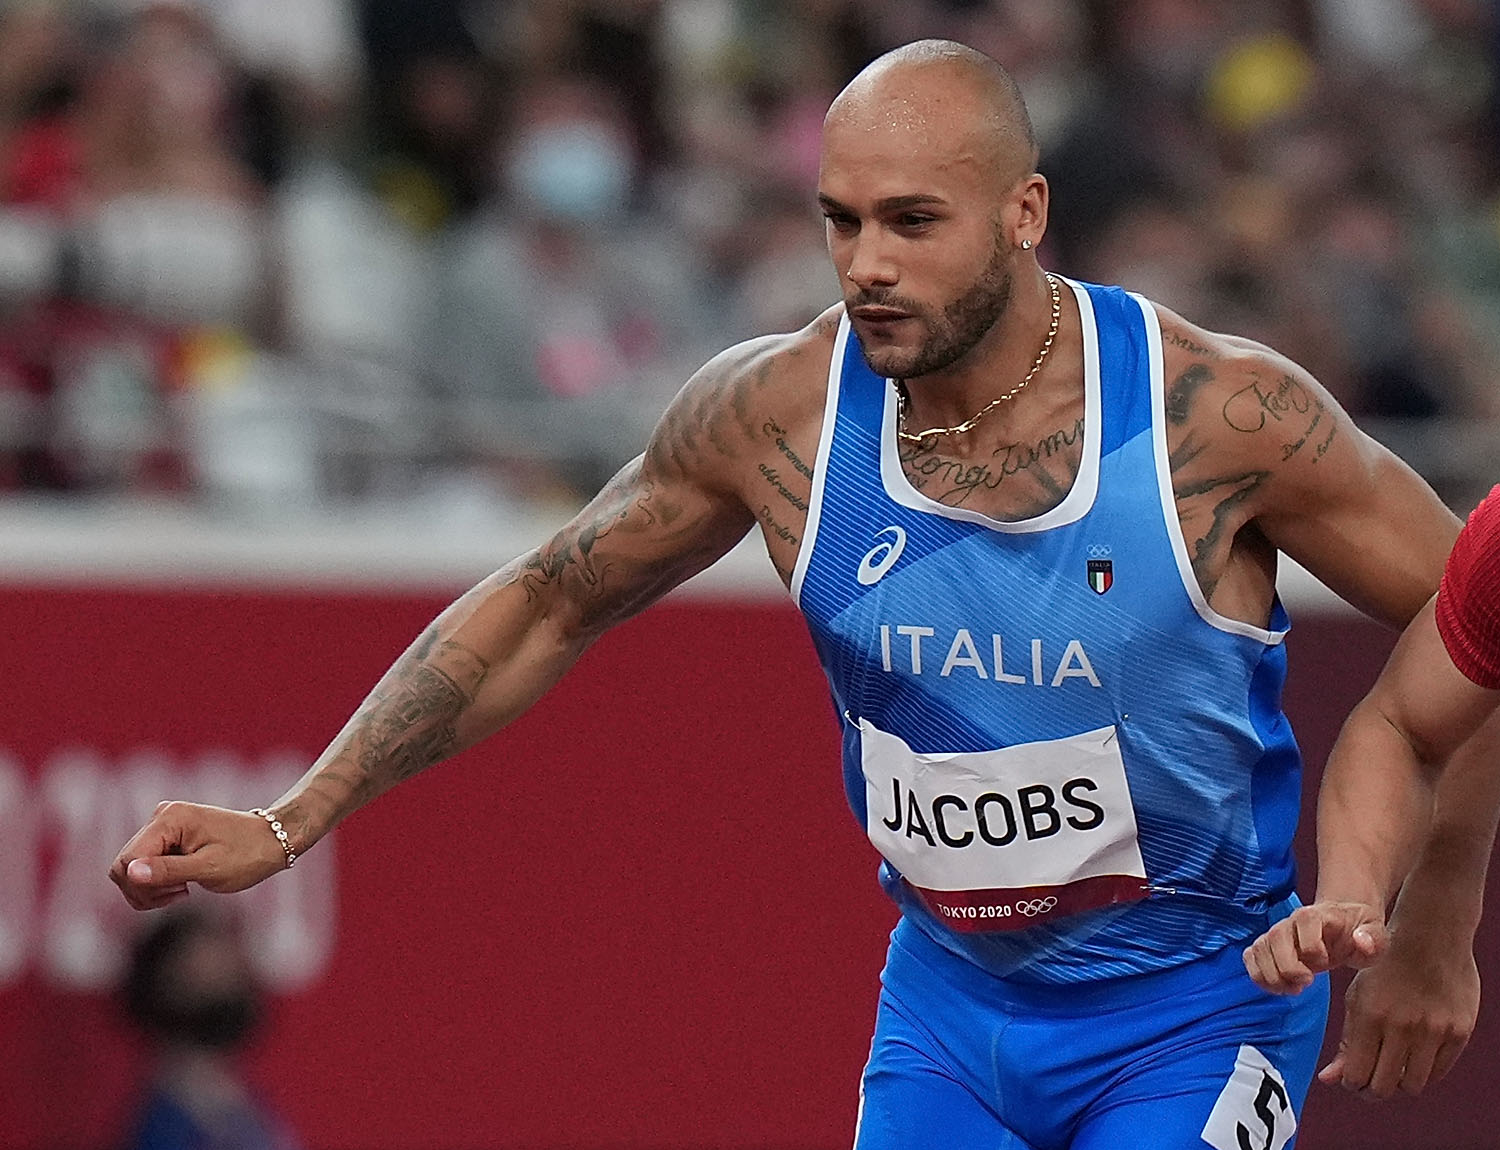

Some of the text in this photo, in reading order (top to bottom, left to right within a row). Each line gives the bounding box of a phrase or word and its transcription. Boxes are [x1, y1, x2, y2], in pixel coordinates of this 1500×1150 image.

[880, 624, 1102, 687] ITALIA
[882, 777, 1105, 849] JACOBS
[937, 903, 1012, 918] TOKYO 2020
